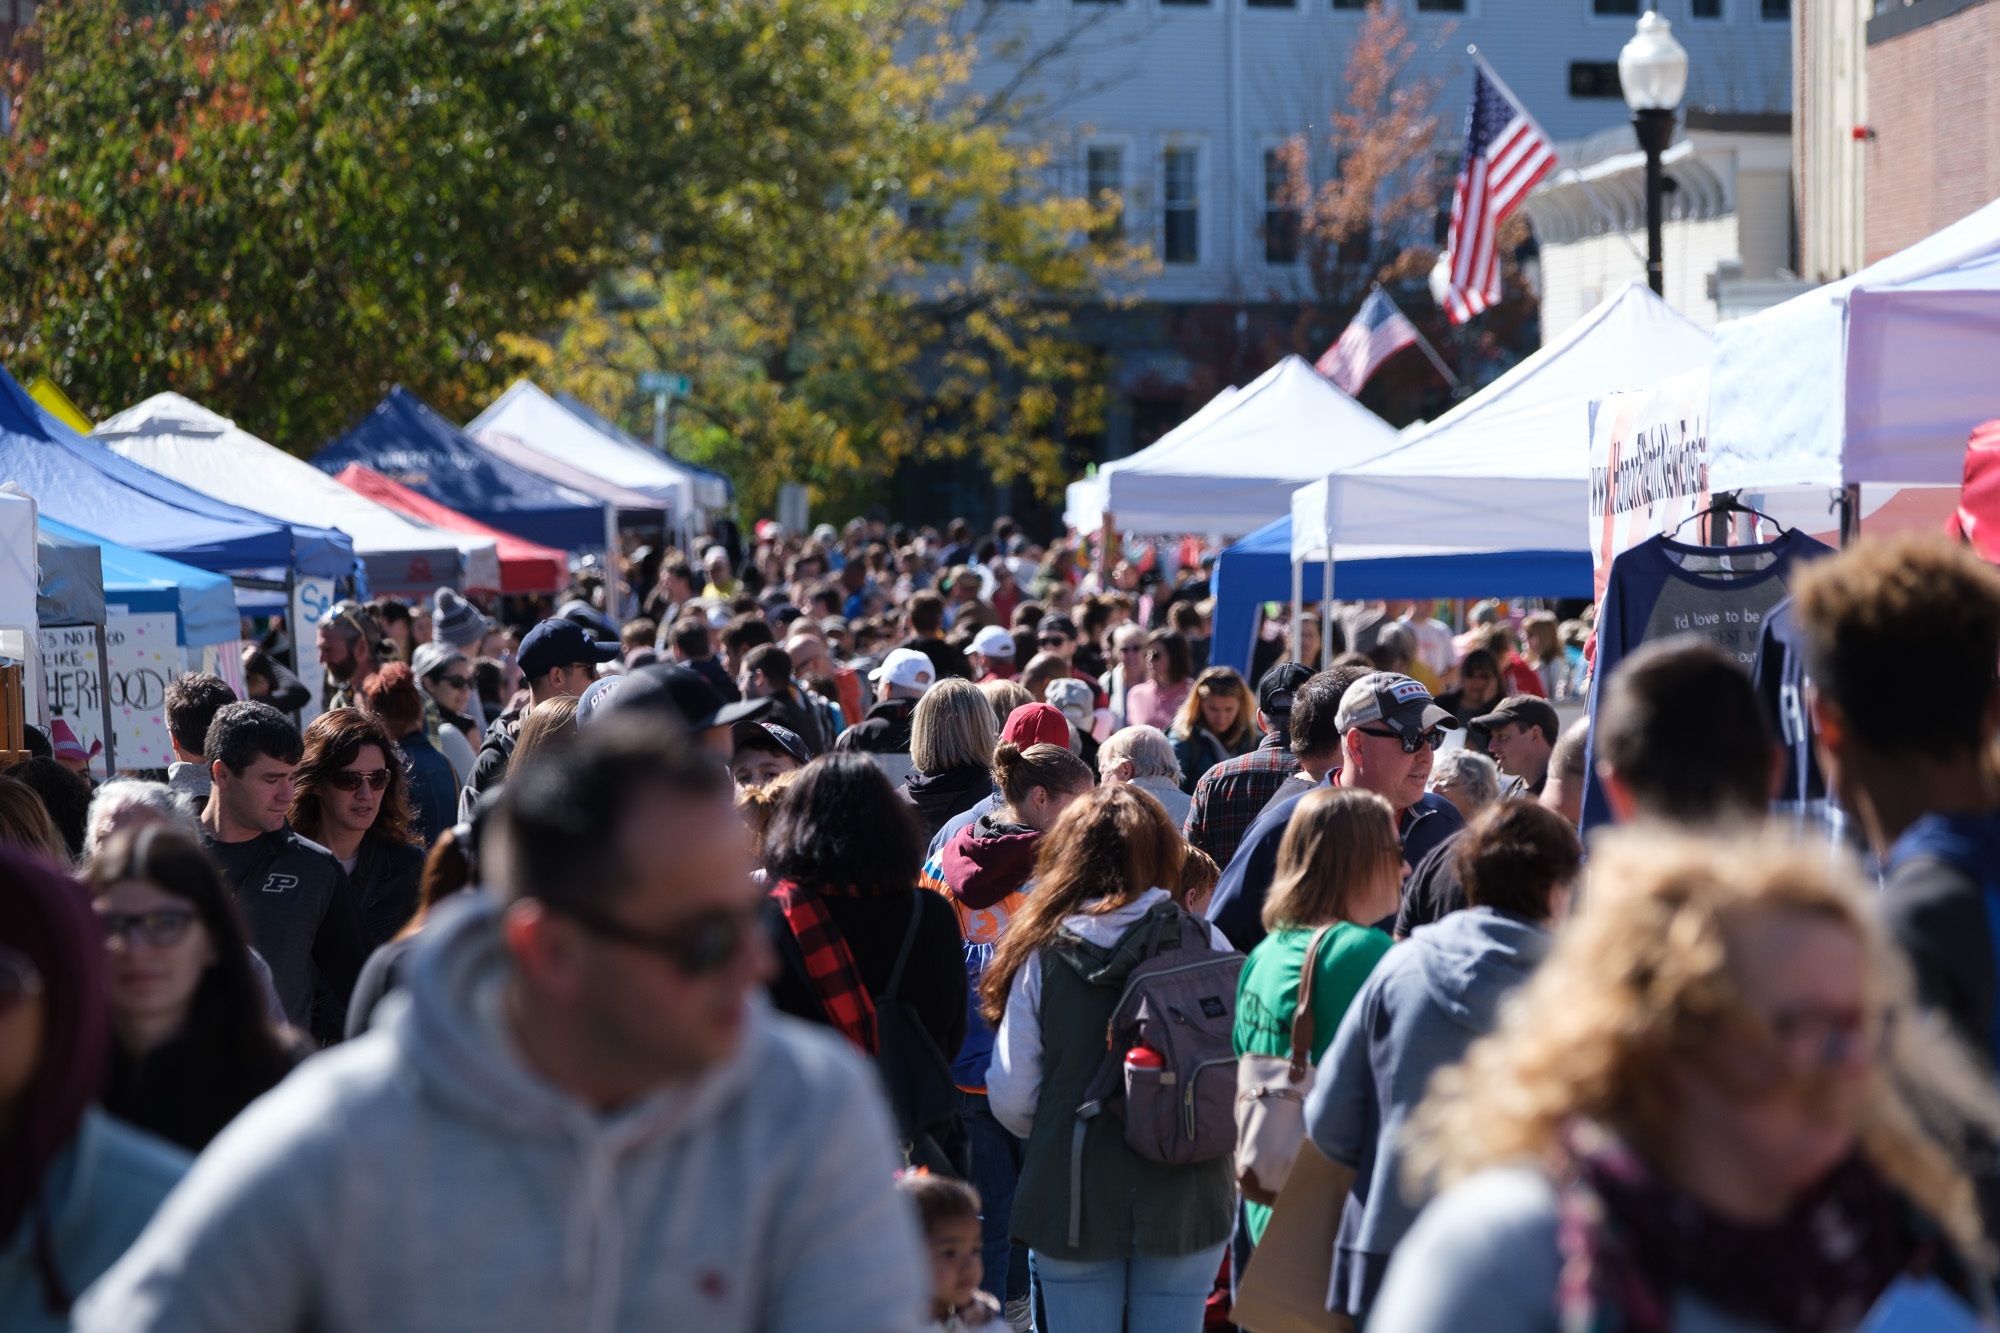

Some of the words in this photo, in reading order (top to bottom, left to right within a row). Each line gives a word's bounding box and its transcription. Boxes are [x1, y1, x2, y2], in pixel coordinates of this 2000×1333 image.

[1675, 615, 1689, 629] I'd
[1694, 612, 1720, 626] love
[1725, 611, 1739, 623] to
[1744, 609, 1760, 623] be
[64, 632, 84, 646] NO
[89, 631, 125, 646] HOD
[43, 651, 83, 668] LIKE
[262, 873, 299, 893] P
